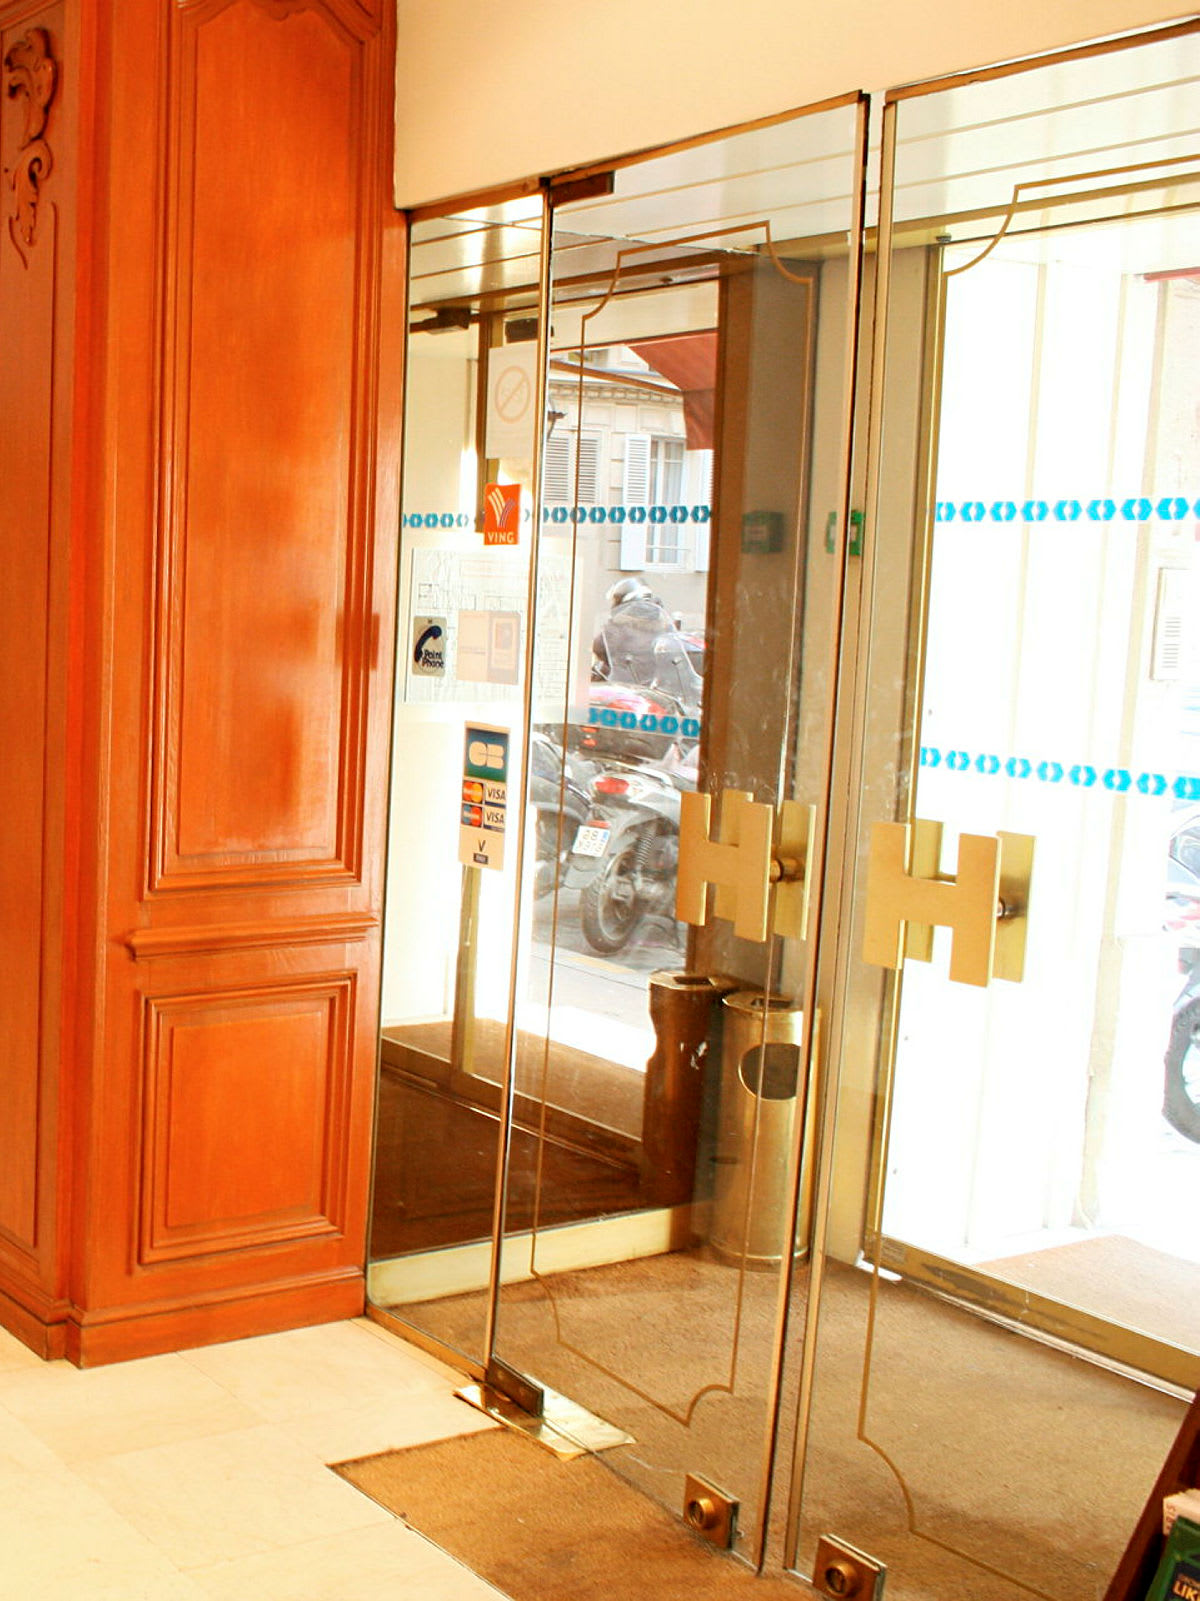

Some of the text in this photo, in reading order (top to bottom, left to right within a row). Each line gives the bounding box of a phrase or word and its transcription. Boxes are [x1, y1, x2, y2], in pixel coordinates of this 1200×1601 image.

[487, 532, 515, 543] VING
[423, 649, 443, 659] Point
[421, 656, 445, 668] Phone
[486, 786, 506, 800] VISA
[485, 810, 505, 825] VISA
